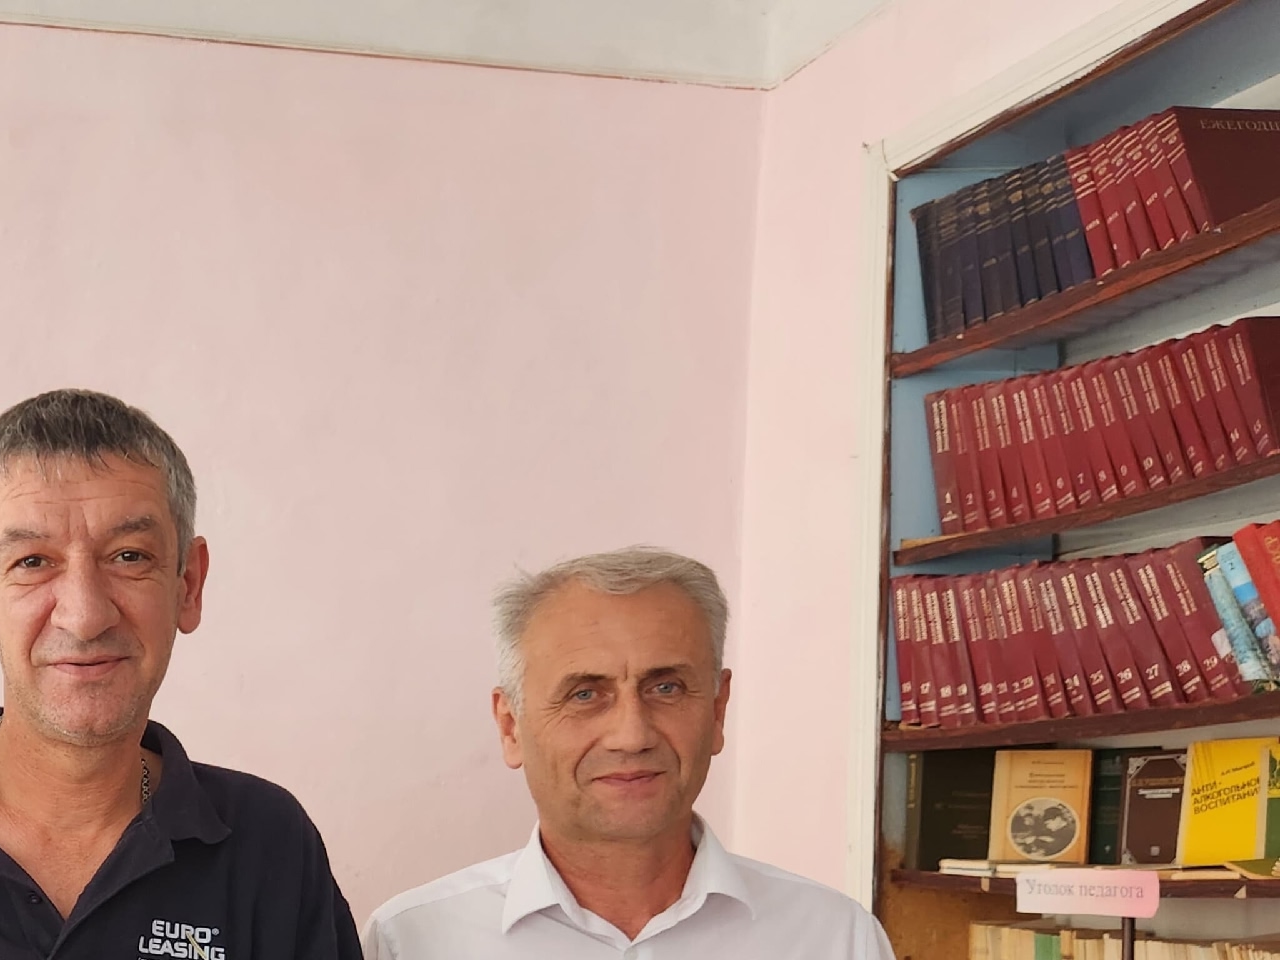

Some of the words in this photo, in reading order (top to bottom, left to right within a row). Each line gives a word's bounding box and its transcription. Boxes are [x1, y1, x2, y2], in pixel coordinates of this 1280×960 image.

[1143, 457, 1153, 470] 10
[1145, 663, 1159, 680] 27
[1176, 659, 1191, 677] 28
[1203, 655, 1218, 671] 29
[1193, 787, 1260, 815] ВОСПИТАНИ
[1025, 879, 1075, 896] Уголок
[1079, 884, 1144, 899] педагога
[152, 920, 212, 943] EURO
